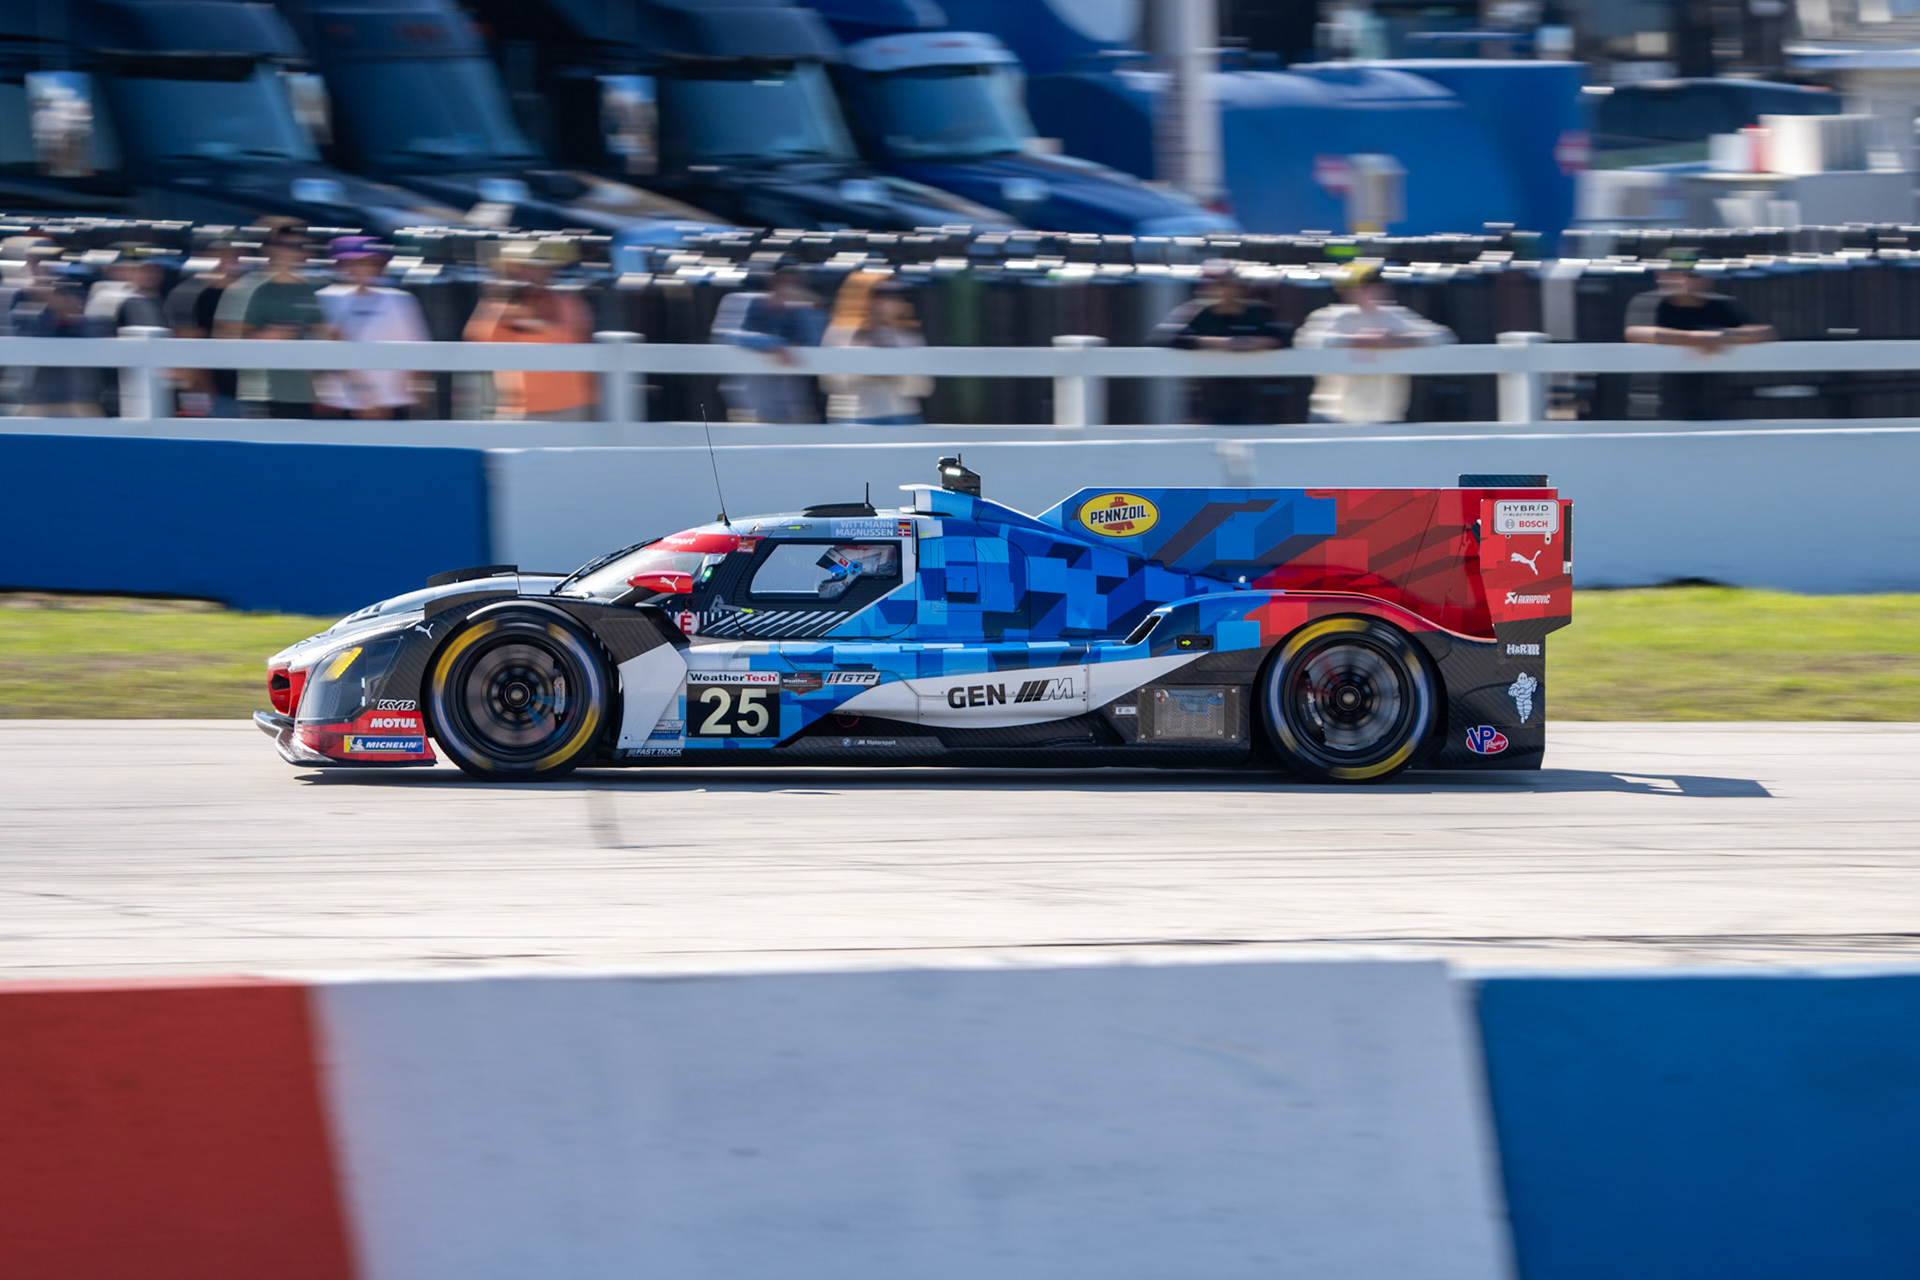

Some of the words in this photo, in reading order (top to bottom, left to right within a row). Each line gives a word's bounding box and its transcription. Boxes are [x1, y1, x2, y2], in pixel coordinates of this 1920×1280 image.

[1089, 504, 1147, 525] PENNZOIL
[690, 673, 776, 682] WeatherTech
[842, 674, 876, 682] GTP
[947, 683, 1007, 709] GEN
[377, 699, 417, 711] KYB
[699, 687, 770, 734] 25
[370, 718, 417, 728] MOTUL
[365, 741, 417, 749] MICHELIN
[1467, 725, 1497, 753] VP
